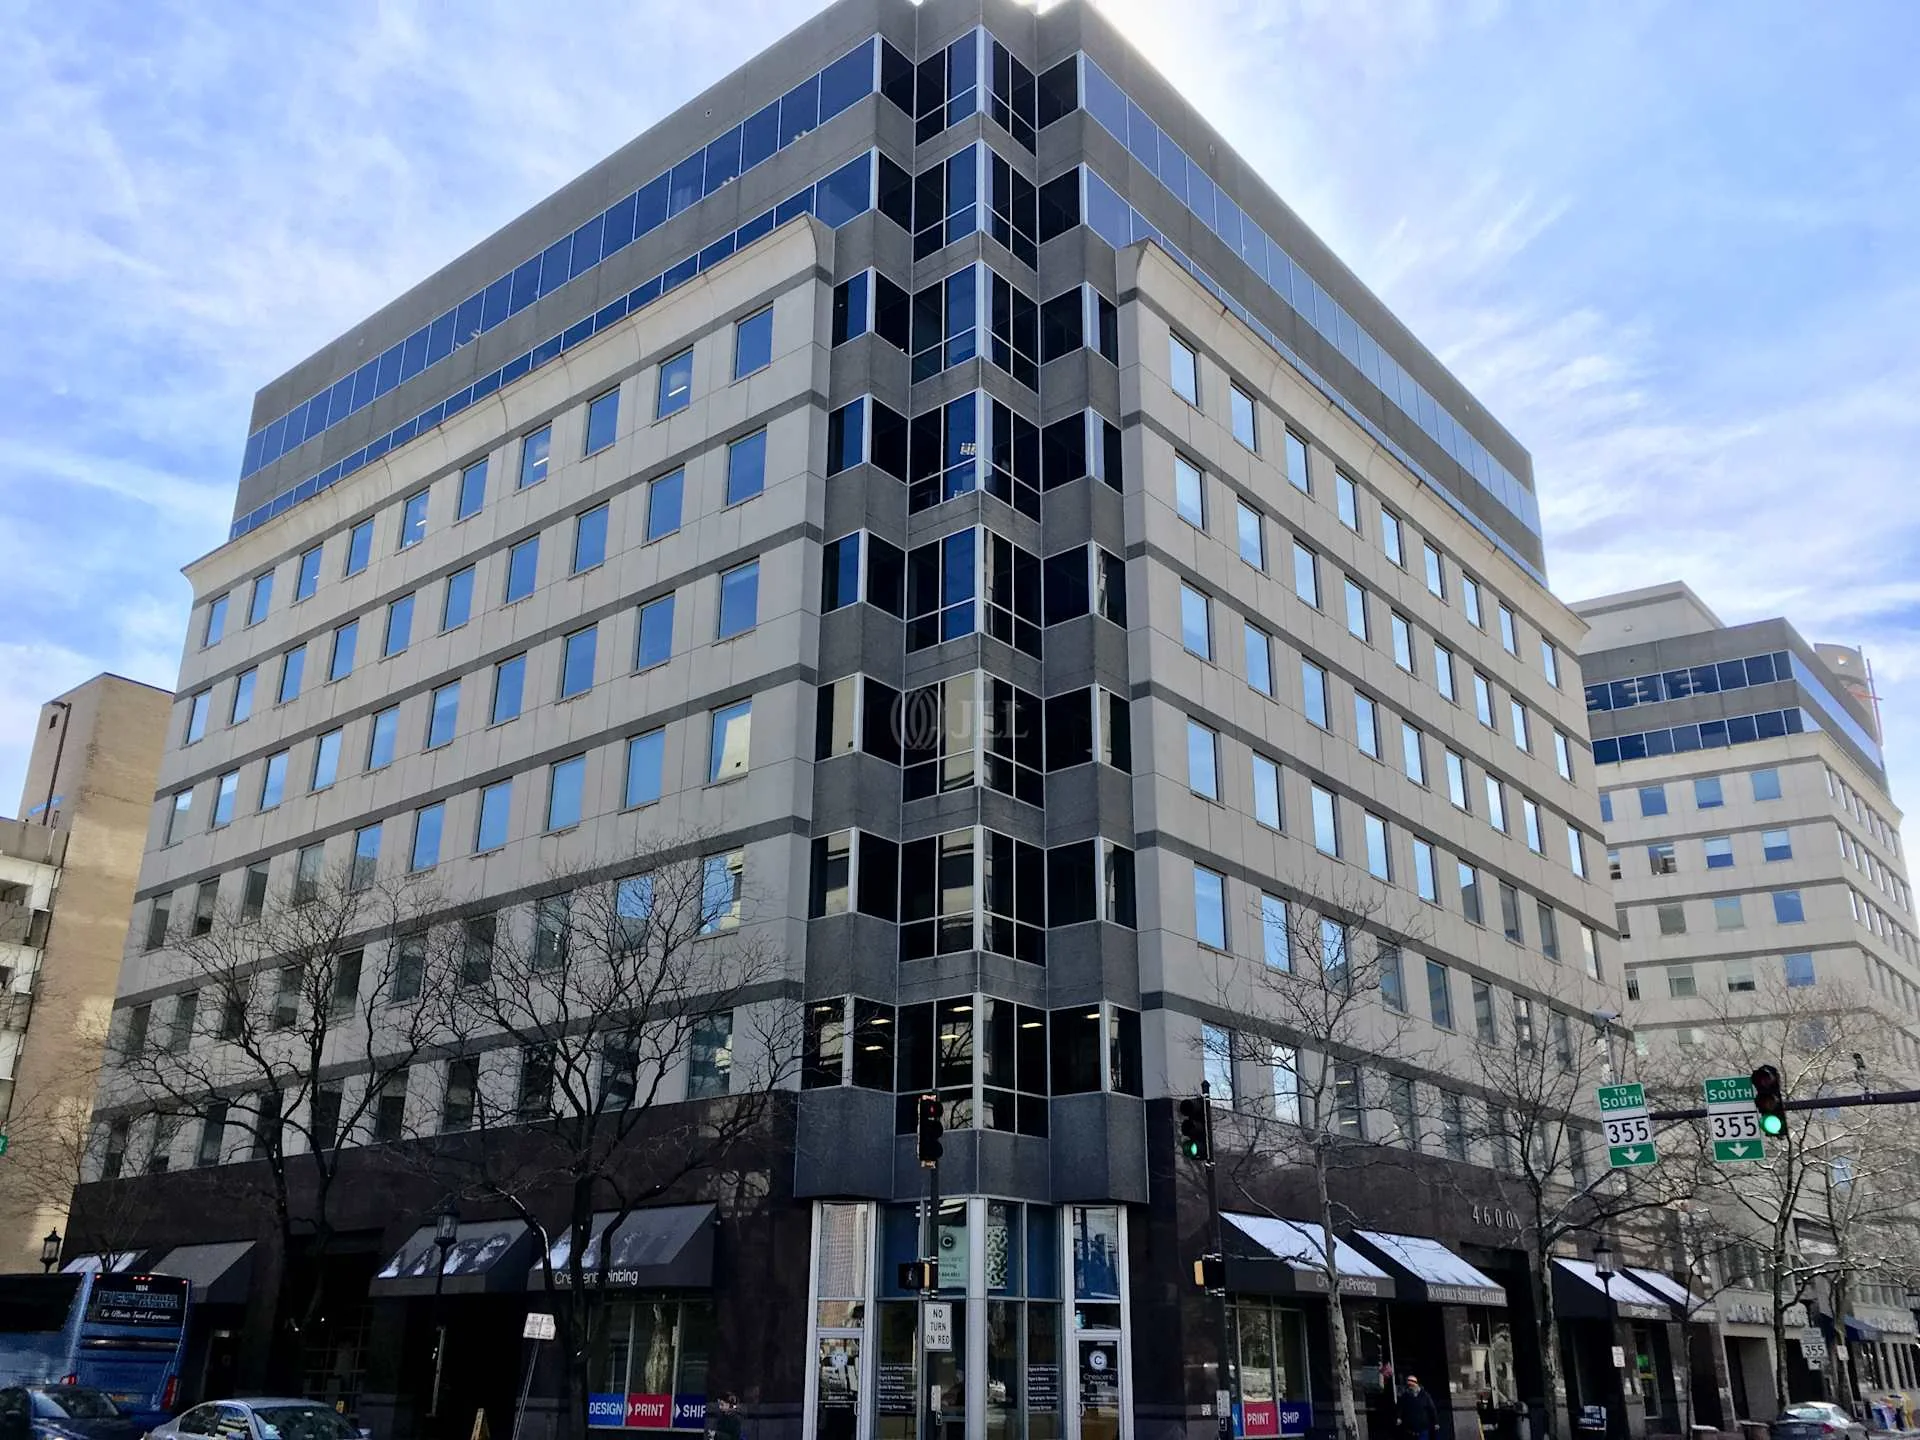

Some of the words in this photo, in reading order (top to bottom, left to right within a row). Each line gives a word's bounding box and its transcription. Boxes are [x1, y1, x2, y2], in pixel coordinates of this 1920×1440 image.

[1721, 1079, 1736, 1088] TO
[1613, 1087, 1627, 1096] TO
[1709, 1089, 1753, 1101] SOUTH
[1602, 1095, 1643, 1109] SOUTH
[1608, 1120, 1649, 1144] 355
[1714, 1115, 1757, 1138] 355
[1472, 1205, 1514, 1229] 4600
[555, 1271, 599, 1285] Creent
[933, 1308, 943, 1319] NO
[930, 1322, 947, 1332] TURN
[926, 1334, 935, 1345] ON
[938, 1335, 950, 1345] RED
[1805, 1344, 1825, 1357] 355
[589, 1402, 623, 1416] DESIGN
[634, 1403, 665, 1417] PRINT
[1247, 1412, 1270, 1426] PRINT
[1282, 1411, 1300, 1425] SHIP
